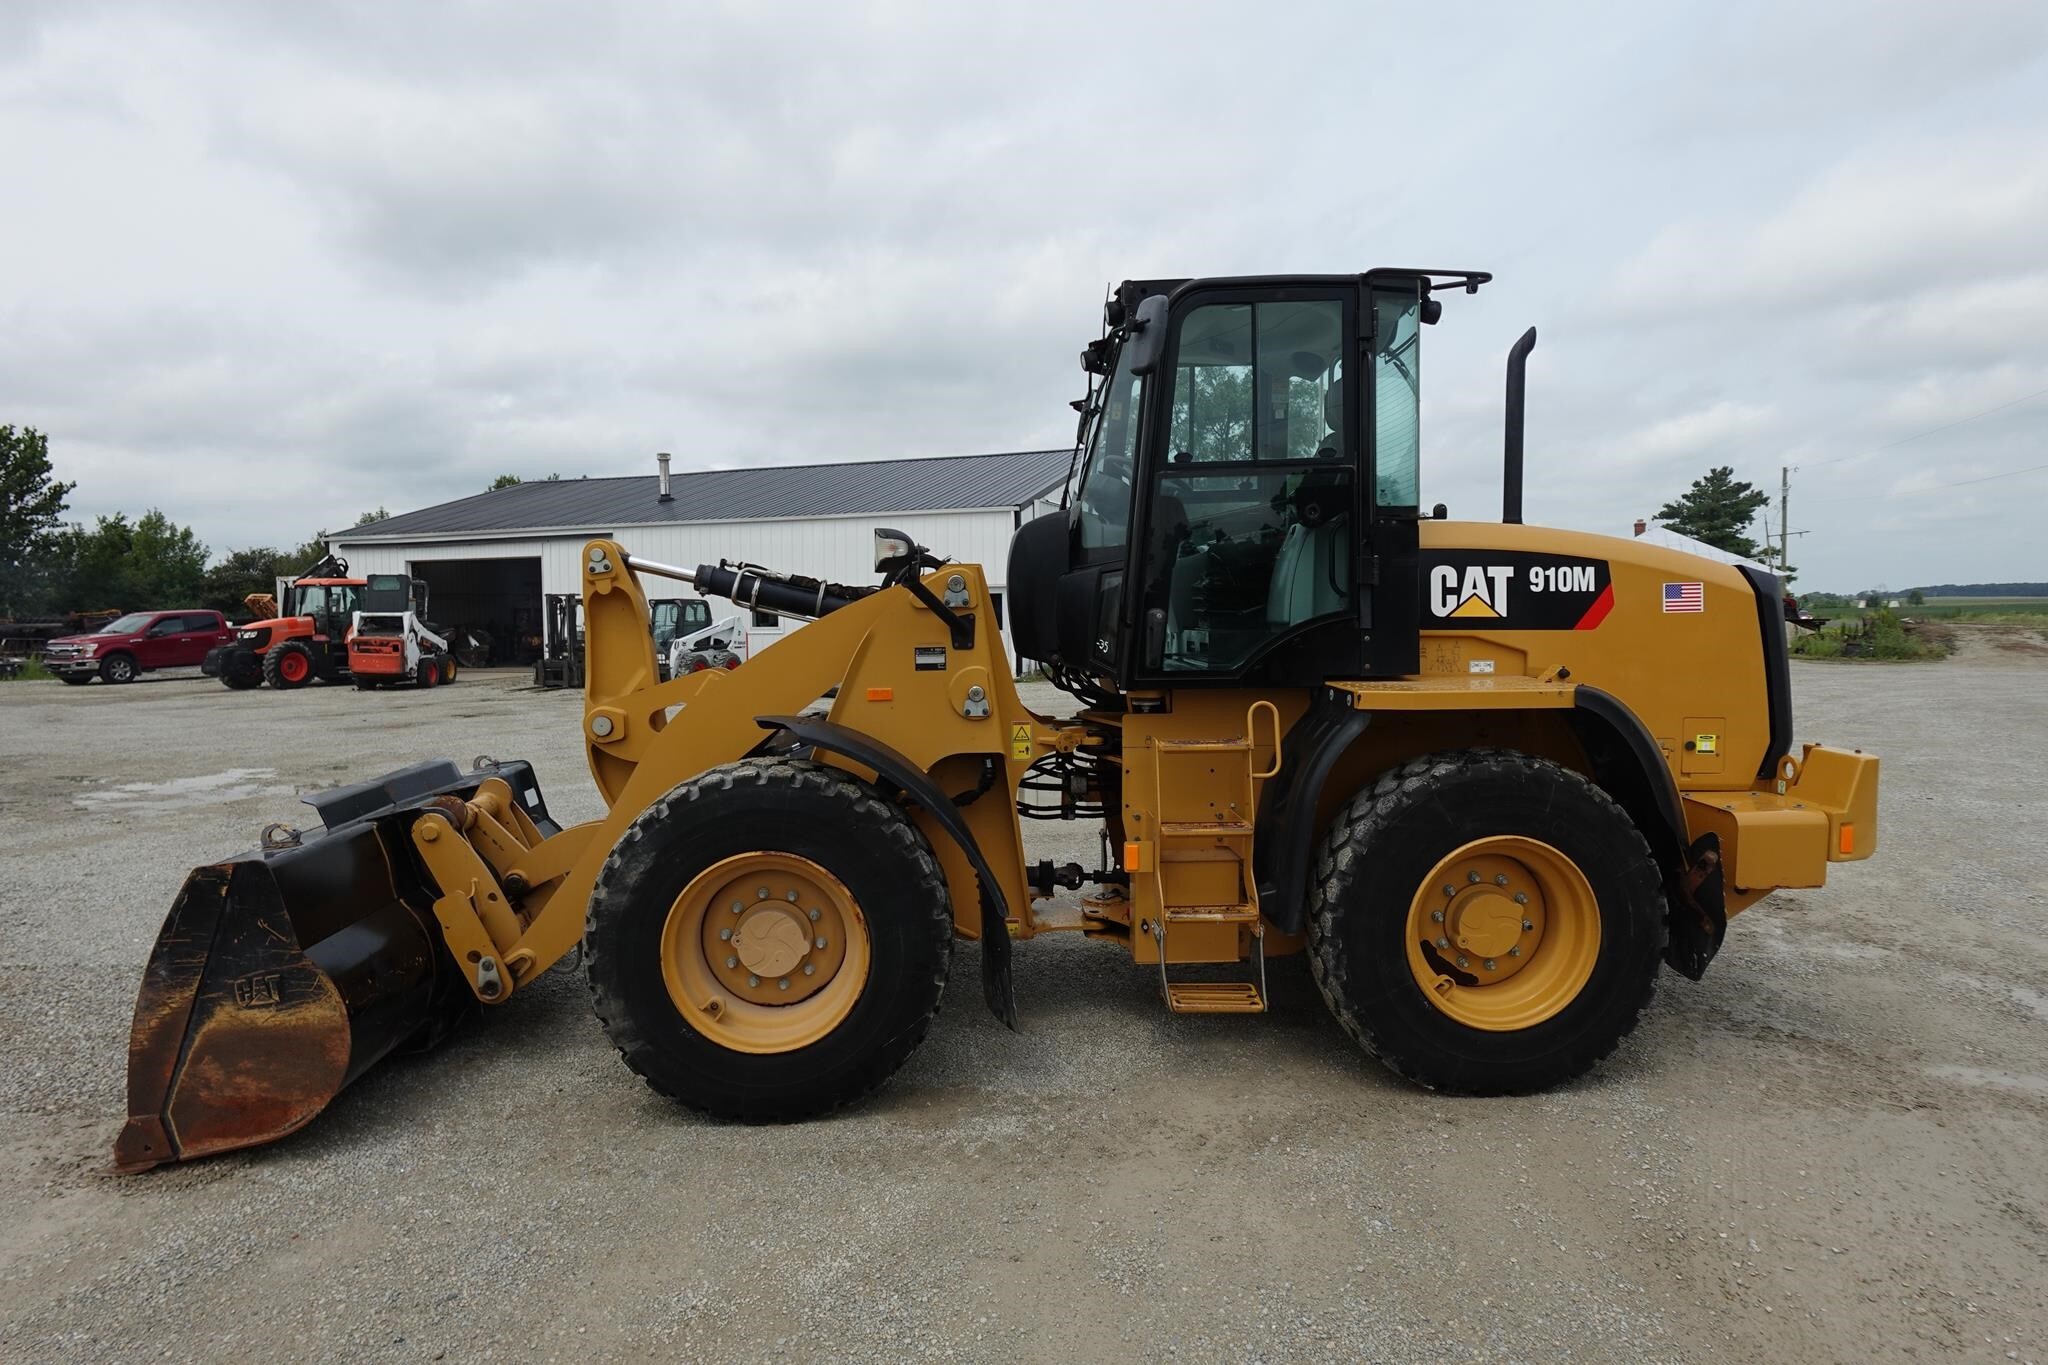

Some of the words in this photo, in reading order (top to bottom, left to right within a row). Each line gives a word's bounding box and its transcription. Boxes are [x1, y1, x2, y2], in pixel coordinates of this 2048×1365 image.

[1430, 565, 1514, 618] CAT
[1529, 566, 1596, 592] 910M
[234, 975, 281, 1007] CAT
